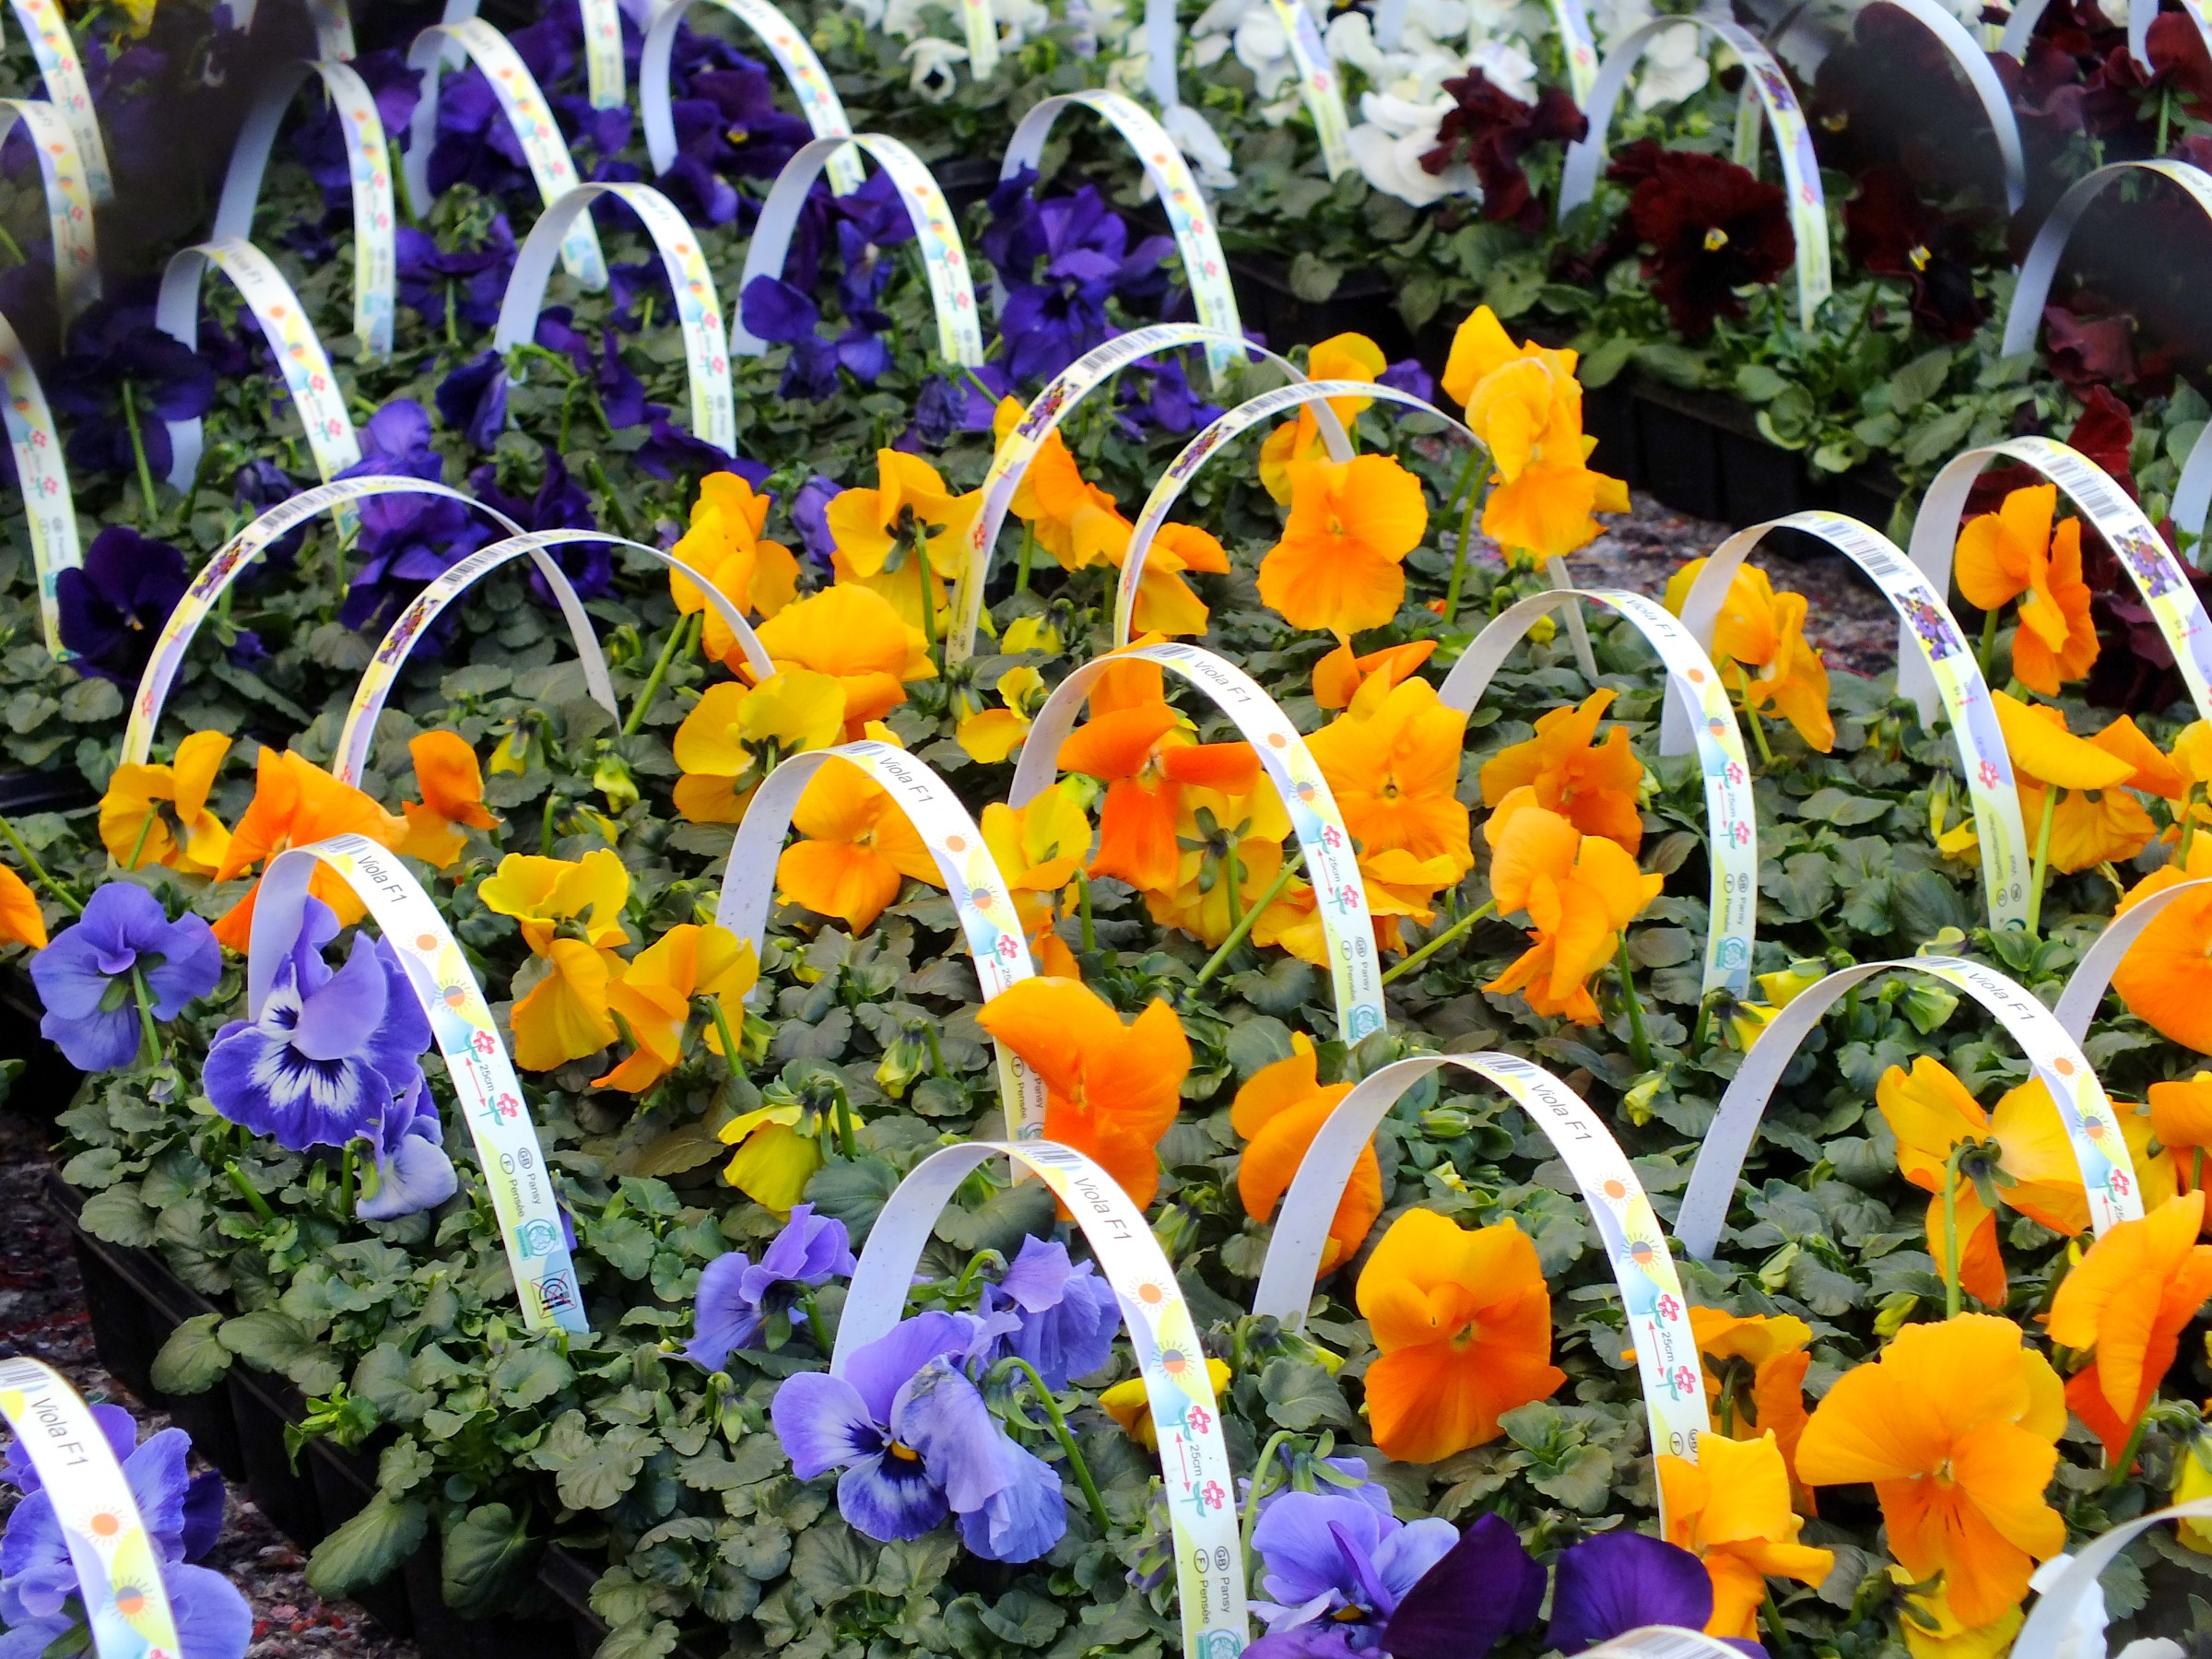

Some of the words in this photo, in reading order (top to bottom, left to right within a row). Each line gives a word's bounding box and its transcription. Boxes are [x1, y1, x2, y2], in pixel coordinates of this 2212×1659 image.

[1654, 624, 1677, 638] F1
[1194, 661, 1230, 685] Viola
[1227, 687, 1252, 702] F1
[879, 757, 912, 783] Viola
[908, 785, 935, 803] F1
[358, 855, 389, 884] Viola
[382, 884, 408, 903] F1
[1328, 856, 1341, 883] 25cm
[1002, 968, 1012, 990] 25c
[1361, 961, 1371, 992] Pansy
[1968, 973, 2009, 999] Viola
[2006, 1003, 2036, 1019] F1
[479, 1064, 495, 1091] 25cm
[1034, 1077, 1044, 1109] Pansy
[1531, 1084, 1570, 1116] Viola
[1564, 1121, 1593, 1140] F1
[509, 1179, 524, 1218] Pensée
[526, 1173, 542, 1205] Pansy
[1074, 1177, 1111, 1213] Viola
[1103, 1219, 1133, 1240] F1
[1662, 1332, 1675, 1362] 25cm
[30, 1397, 69, 1440] Viola
[57, 1441, 89, 1467] F1
[1190, 1444, 1203, 1477] 25cm
[1216, 1548, 1228, 1568] GB
[1200, 1579, 1211, 1624] Pensée
[1220, 1576, 1231, 1614] Pansy
